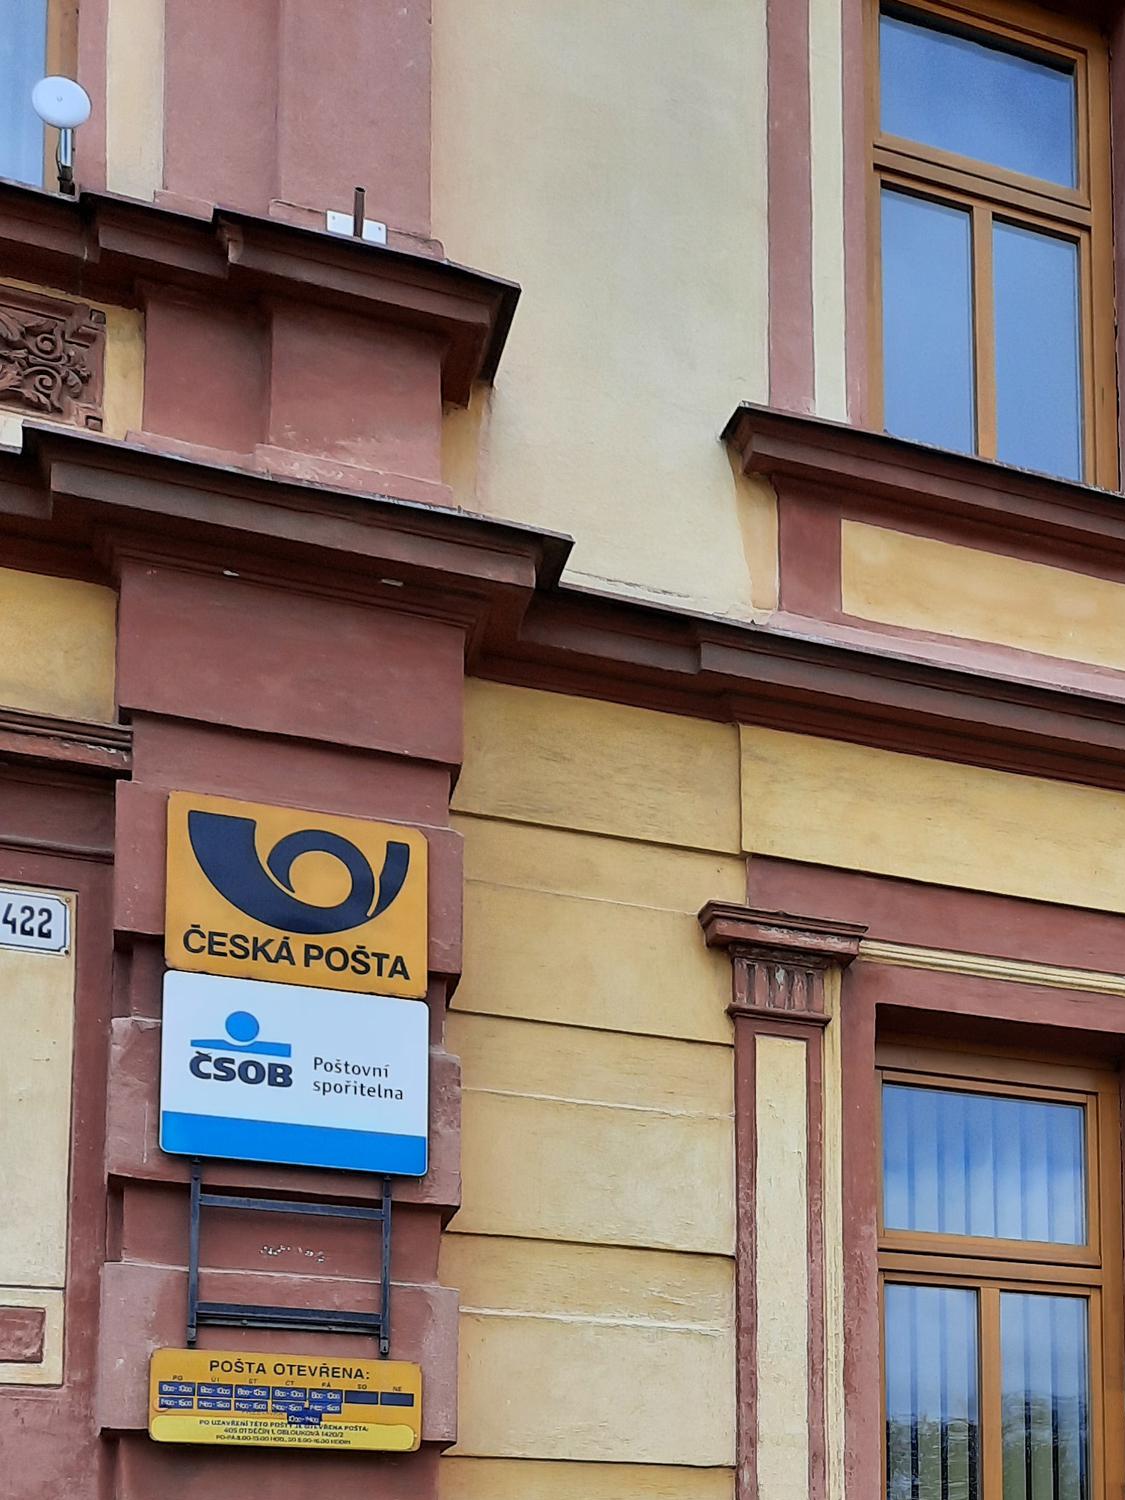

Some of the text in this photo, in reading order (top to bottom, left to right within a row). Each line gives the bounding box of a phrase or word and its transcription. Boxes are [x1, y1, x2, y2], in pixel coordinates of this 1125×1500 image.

[2, 903, 52, 939] 422
[182, 923, 411, 981] ČESKÁ POŠTA
[188, 1050, 294, 1088] ČSOB
[313, 1056, 391, 1079] Poštovní
[312, 1079, 404, 1101] spořitelna
[209, 1358, 370, 1380] POŠTA OTEVŘENA:
